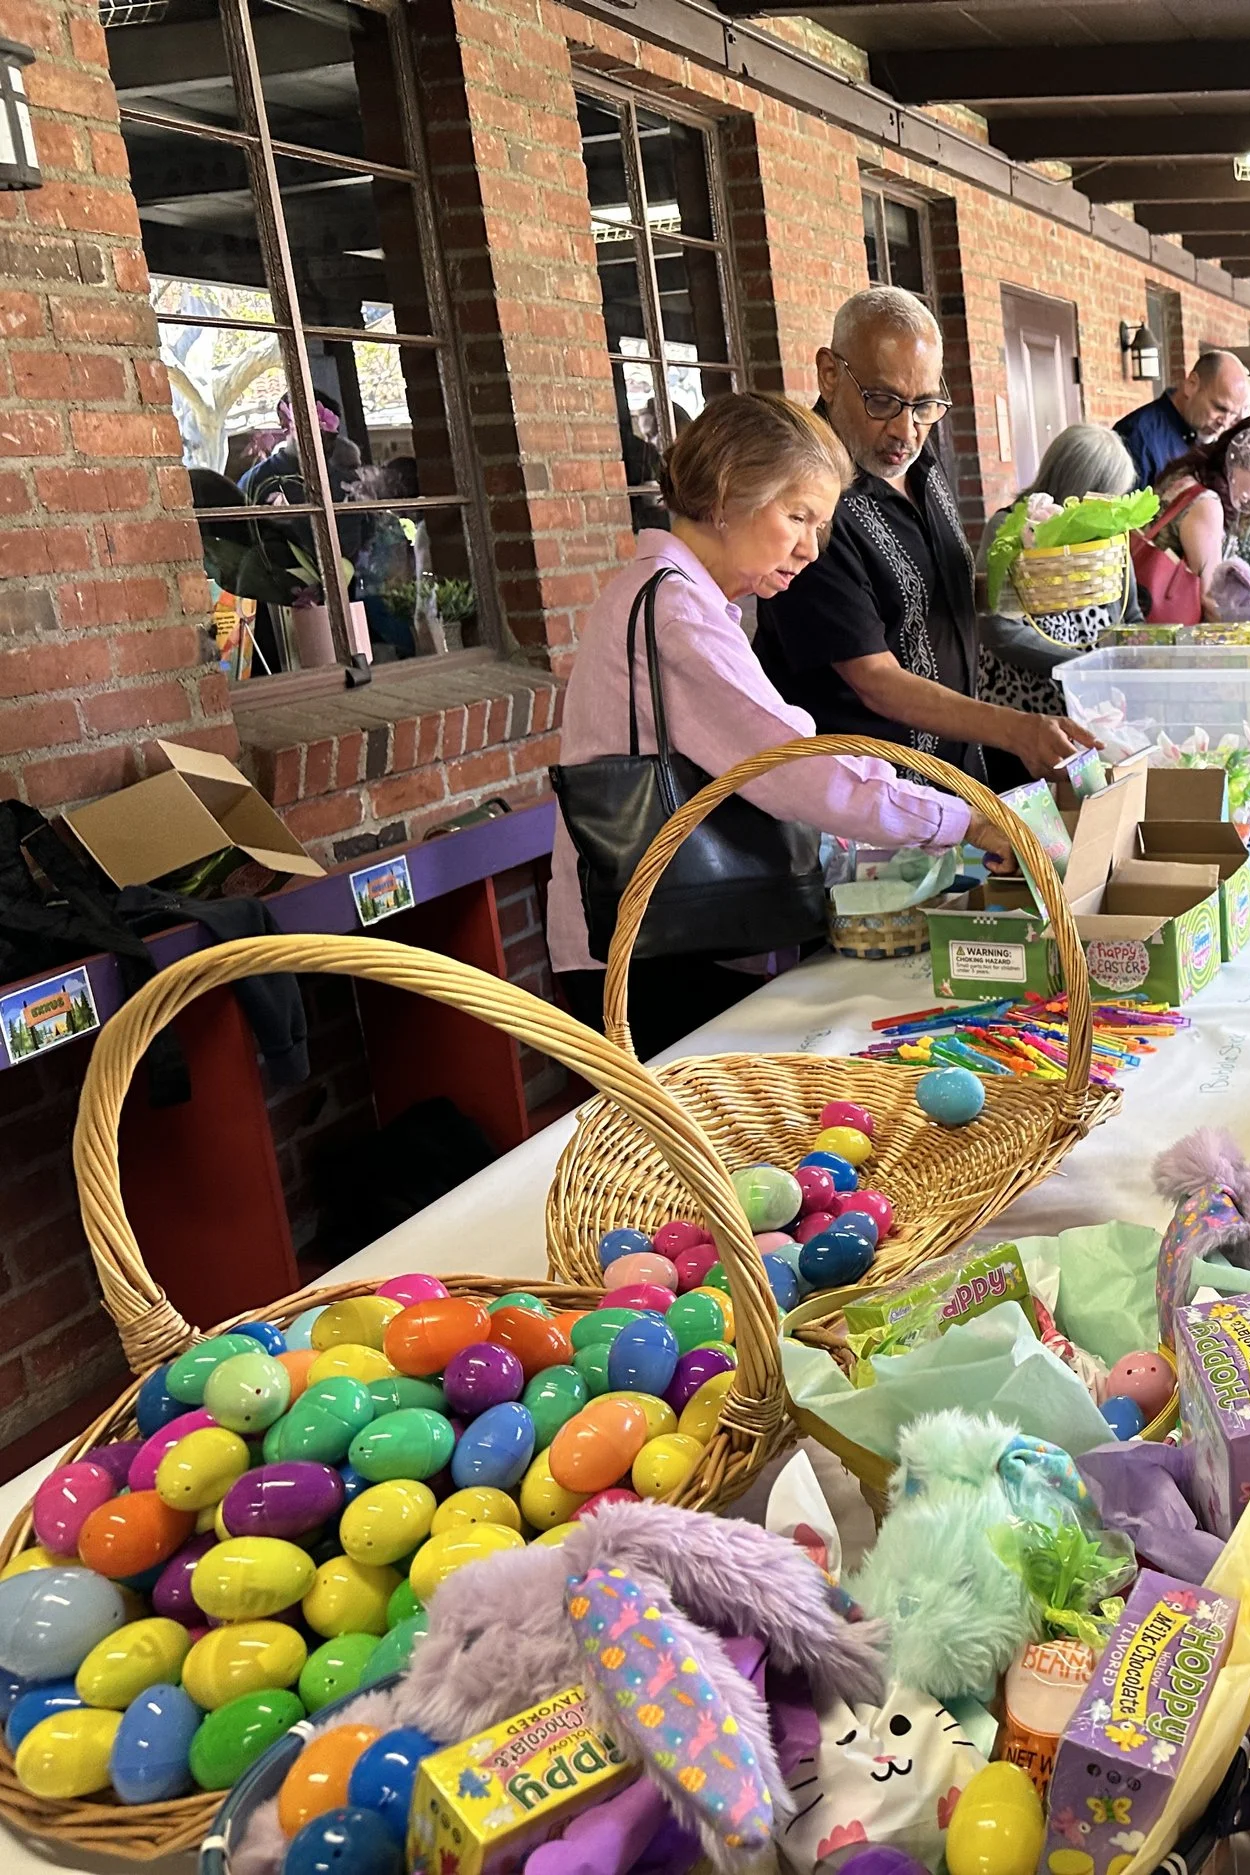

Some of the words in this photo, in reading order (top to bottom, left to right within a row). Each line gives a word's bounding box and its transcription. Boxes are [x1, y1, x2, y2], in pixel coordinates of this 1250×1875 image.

[966, 947, 1012, 958] WARNING:
[1097, 960, 1141, 974] EASTER
[936, 1266, 1008, 1322] appy
[1186, 1319, 1250, 1410] Hoppy
[1101, 1621, 1140, 1687] FLAVORED
[1141, 1611, 1177, 1646] Milk
[1118, 1643, 1157, 1715] Chocolate
[1146, 1622, 1227, 1746] Hoppy
[1150, 1650, 1172, 1688] HOLLOW
[494, 1708, 585, 1770] Chocolate
[506, 1690, 583, 1736] LAVORED
[507, 1732, 628, 1811] ippy
[1006, 1746, 1038, 1769] NET
